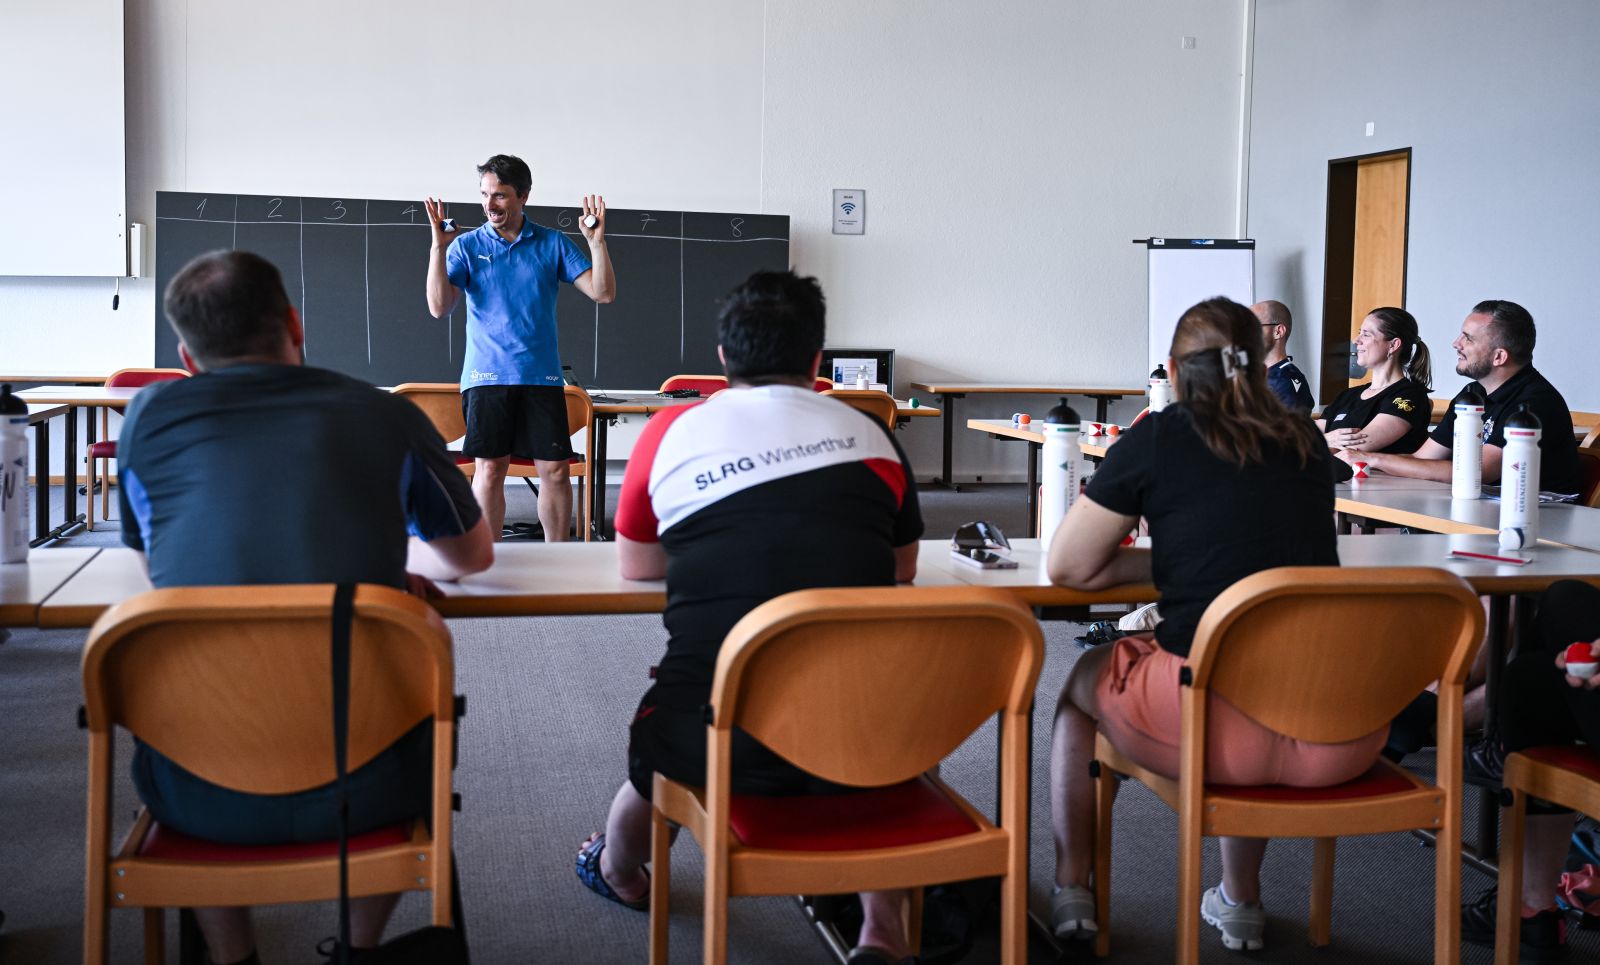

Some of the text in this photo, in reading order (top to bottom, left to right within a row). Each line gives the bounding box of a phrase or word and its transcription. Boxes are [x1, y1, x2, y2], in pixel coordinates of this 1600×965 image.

[196, 198, 744, 237] 1 2 3 4 6 7 8
[694, 436, 857, 491] SLRG Winterthur
[1519, 462, 1527, 513] KERENZERBERG
